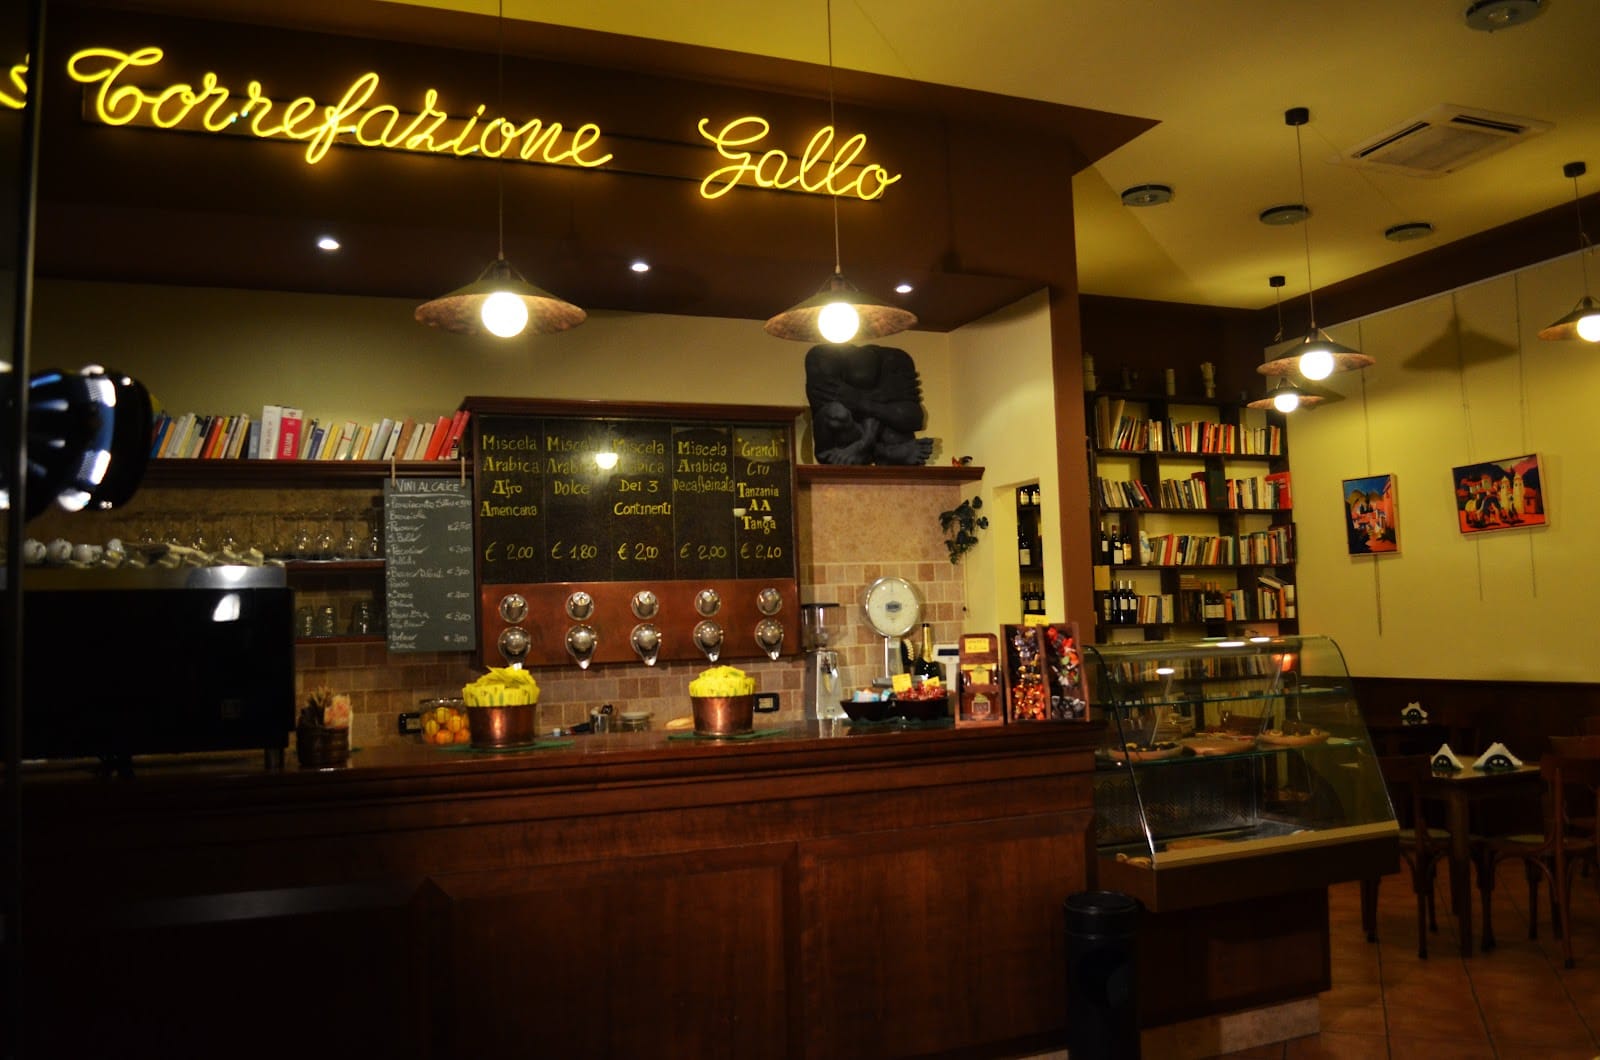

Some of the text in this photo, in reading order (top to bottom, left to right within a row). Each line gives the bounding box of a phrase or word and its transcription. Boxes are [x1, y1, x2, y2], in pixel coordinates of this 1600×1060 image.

[66, 46, 613, 168] Torrefazione
[698, 116, 902, 201] Gallo
[482, 435, 537, 450] Miscela
[547, 436, 600, 452] Miscel
[677, 440, 728, 456] Miscela
[741, 439, 779, 458] Grandi
[482, 456, 540, 473] Arabica
[615, 458, 665, 473] Aabica
[677, 458, 728, 473] Arabica
[747, 462, 770, 477] Cru
[396, 479, 416, 492] VINI
[418, 481, 431, 492] AL
[492, 479, 523, 498] Afro
[554, 480, 590, 495] Dolce
[619, 480, 659, 493] Dei 3
[737, 482, 779, 498] Tanzania
[741, 515, 777, 535] Tanga
[485, 541, 497, 561] €
[551, 541, 563, 560] €
[617, 543, 628, 560] €
[679, 542, 691, 559] €
[740, 543, 751, 559] €
